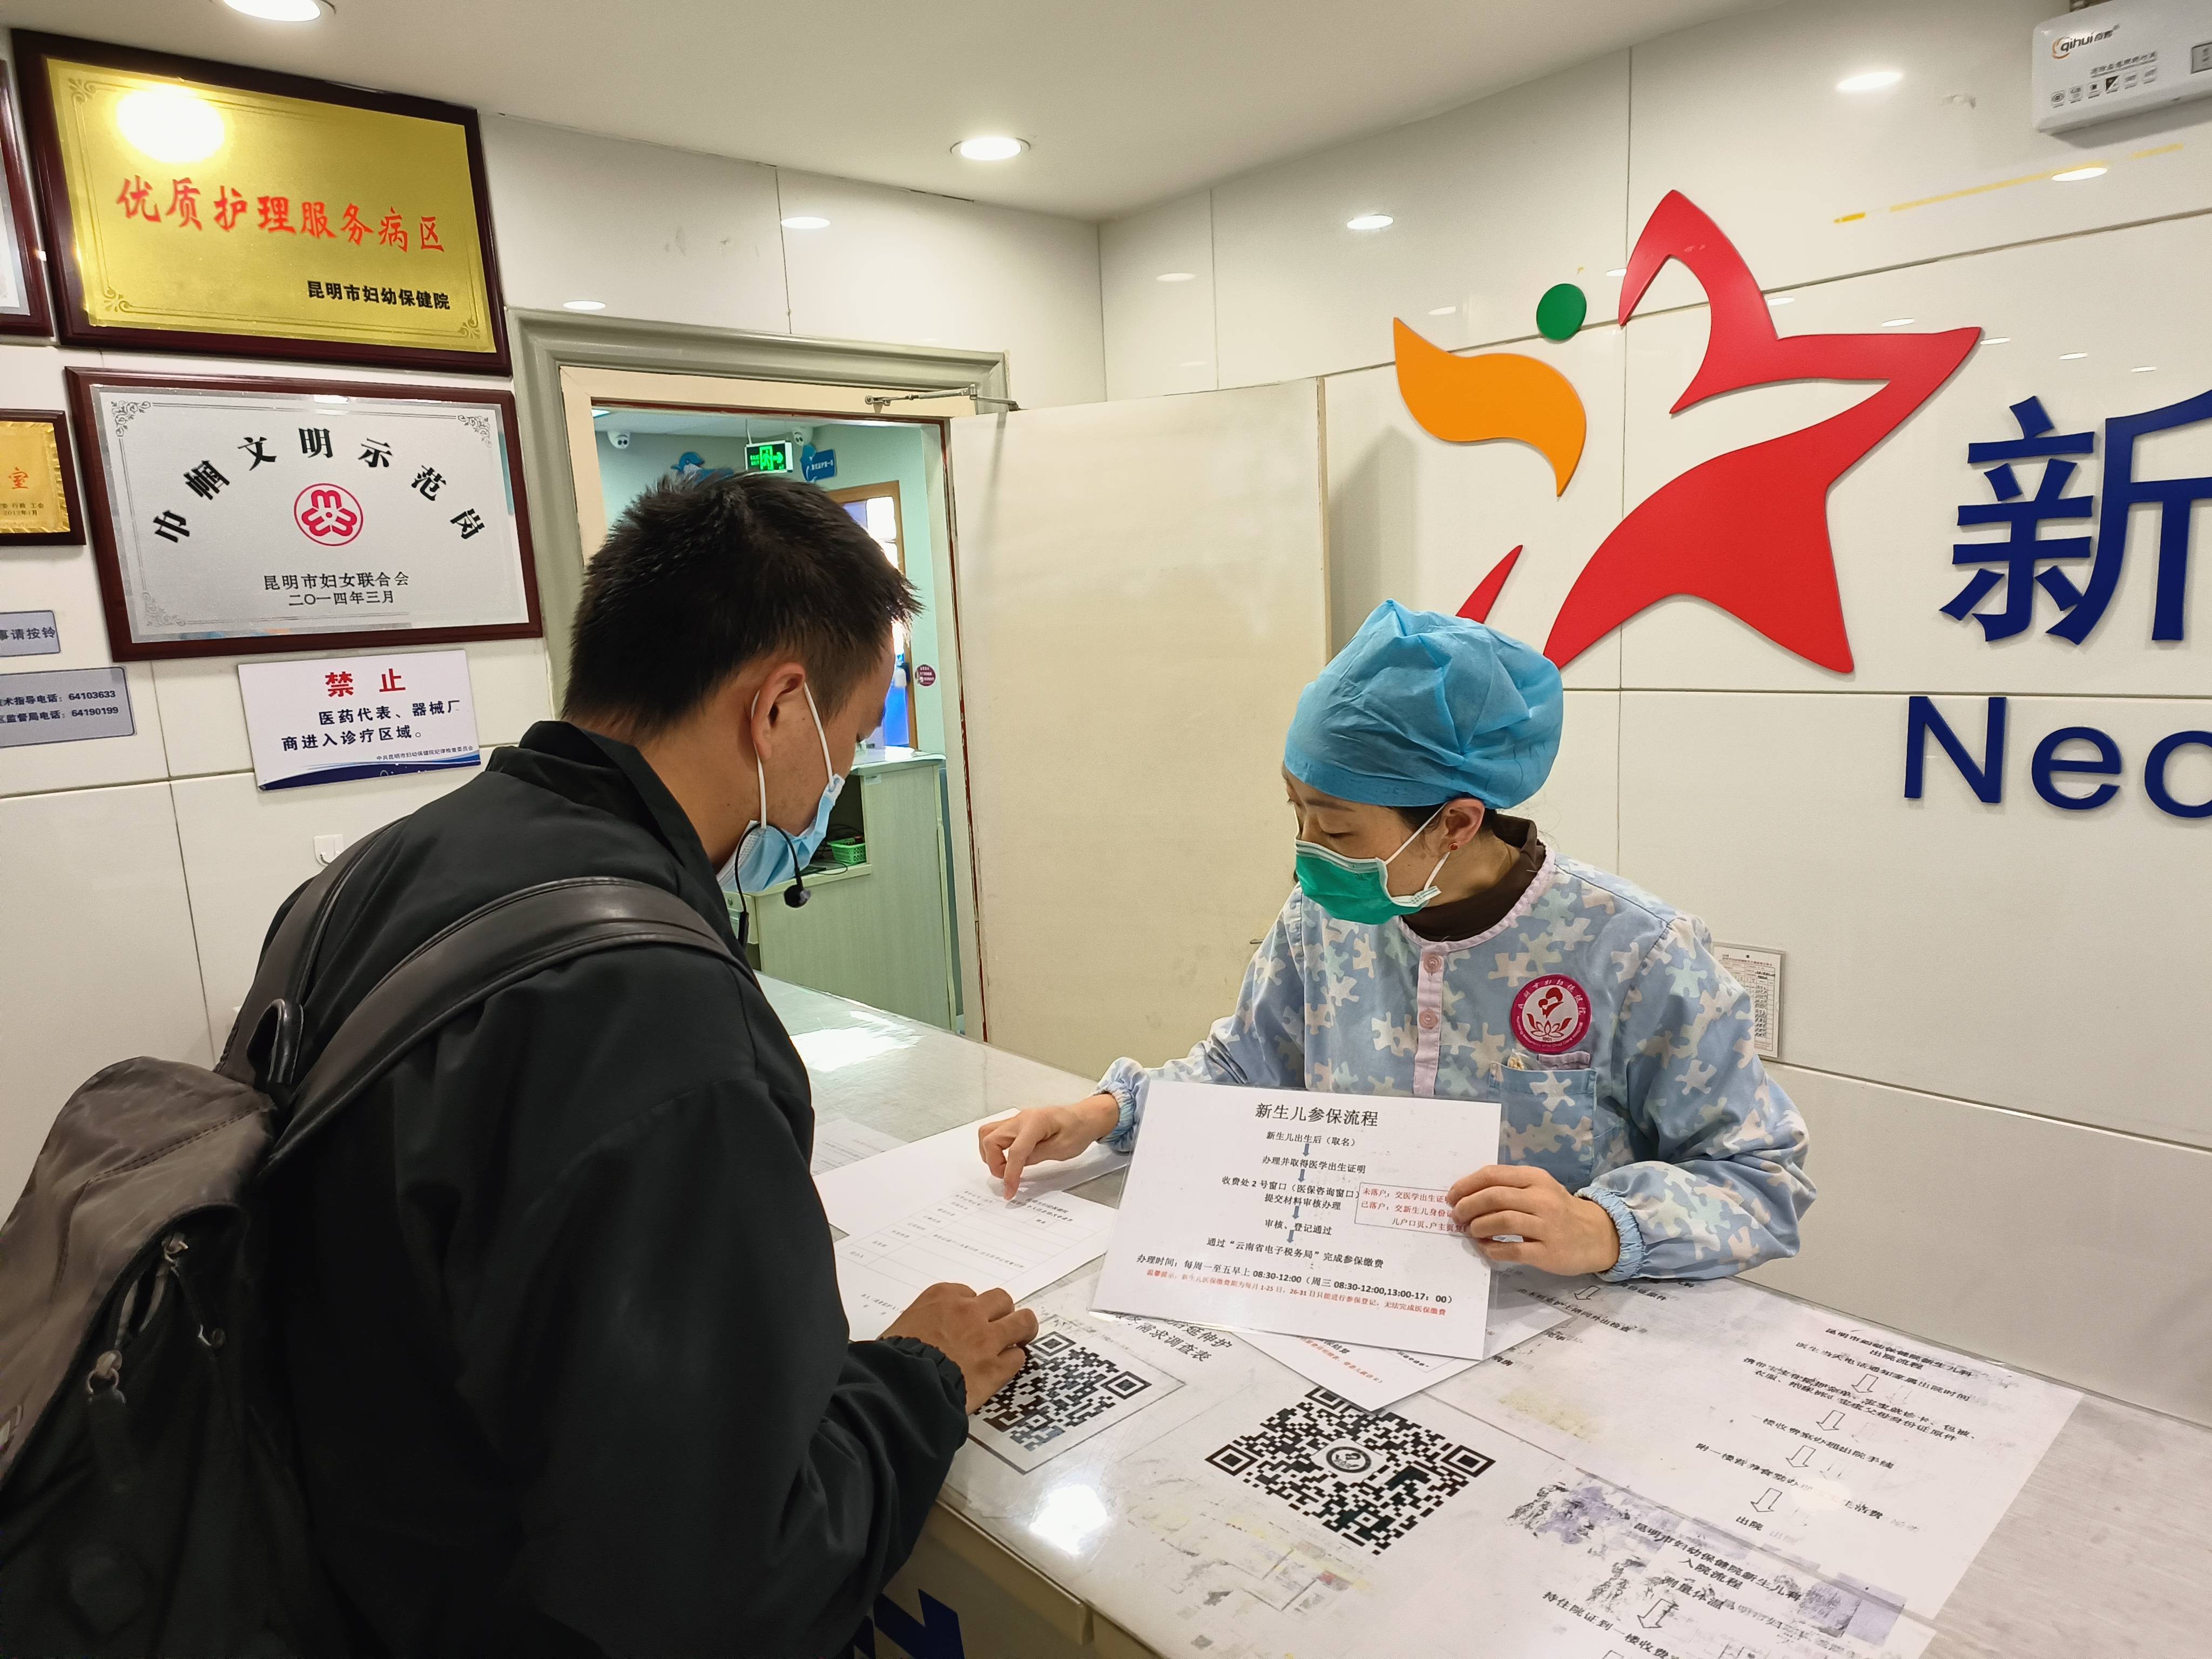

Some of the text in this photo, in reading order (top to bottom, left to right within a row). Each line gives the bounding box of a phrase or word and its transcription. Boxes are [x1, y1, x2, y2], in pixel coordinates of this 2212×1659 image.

[116, 174, 446, 254] 优质护理服务病区
[306, 279, 451, 311] 昆明市妇幼保健院
[9, 467, 29, 489] 室
[152, 426, 485, 544] 巾帼文明示范岗
[262, 569, 411, 591] 昆明市妇女联合会
[0, 690, 116, 706] 术指导电话： 64103633
[71, 706, 119, 717] 64190199
[318, 700, 461, 726] 医药代表、器械厂
[281, 725, 421, 752] 商进入诊疗区域。
[1255, 1103, 1379, 1127] 新生儿参保流程
[1266, 1131, 1357, 1147] 新生儿出生后（取名）
[1262, 1155, 1366, 1175] 办理并取得医学出生证明
[1264, 1192, 1341, 1211] 提交材料审核办理
[1264, 1218, 1333, 1236] 审核、登记通过
[1678, 1558, 1744, 1590] 入院流程
